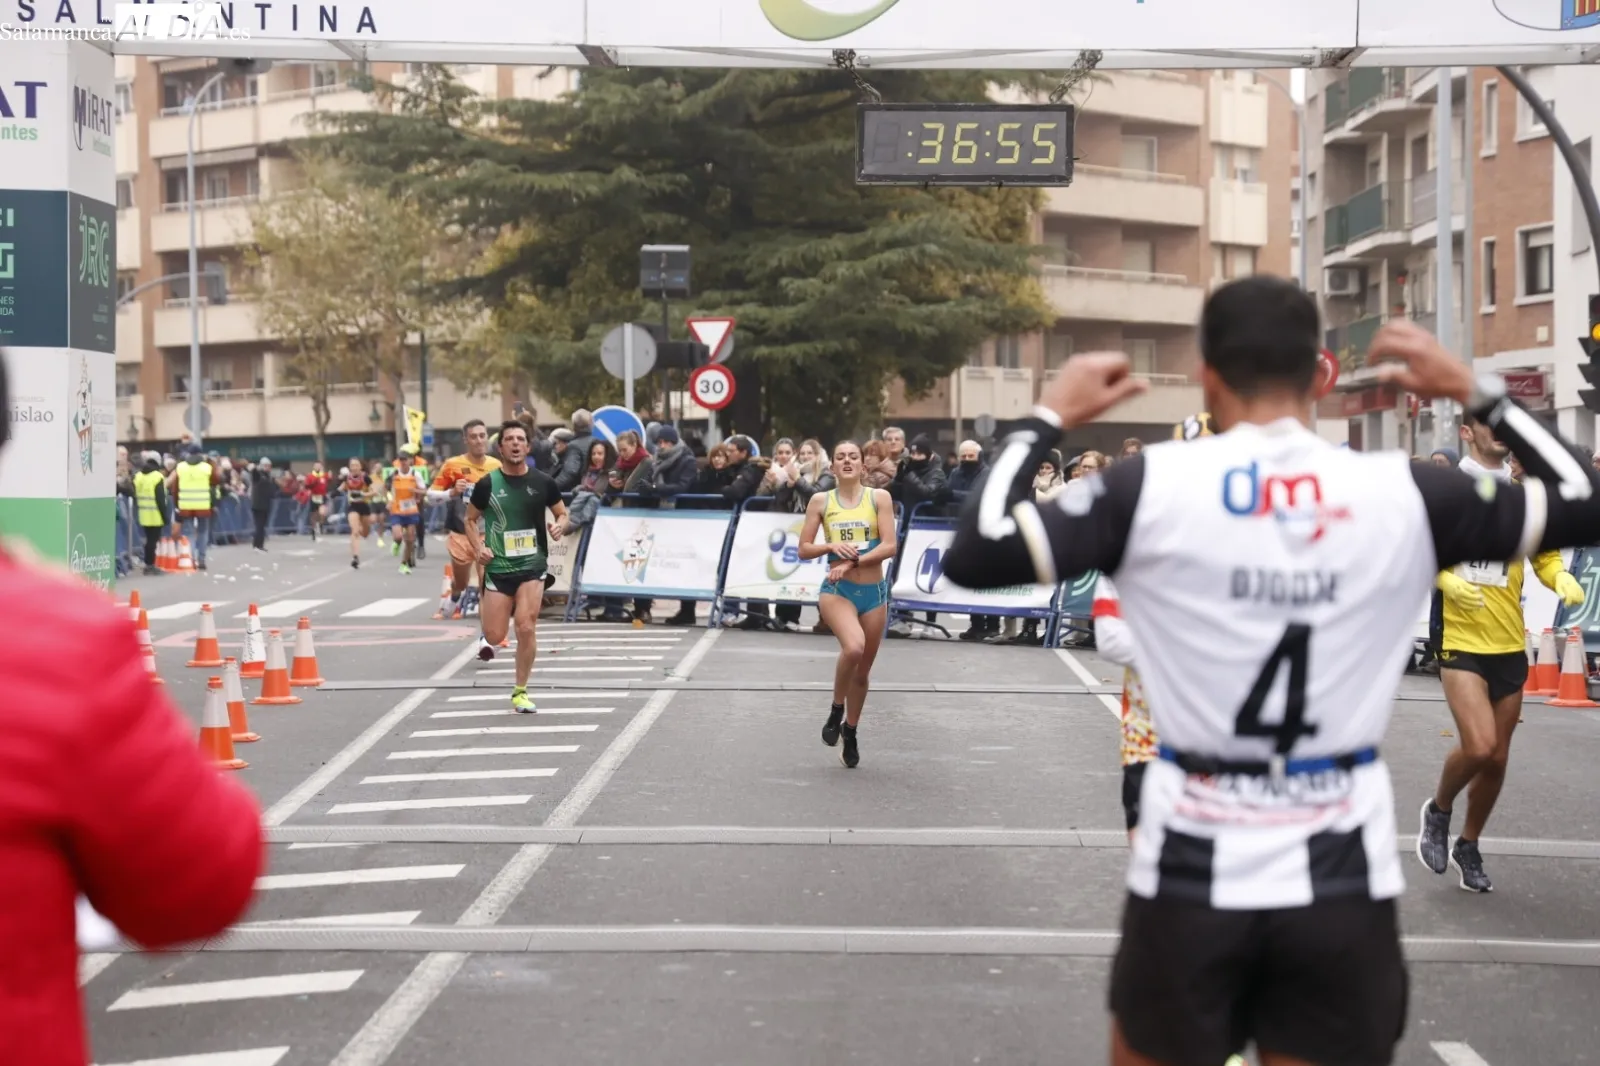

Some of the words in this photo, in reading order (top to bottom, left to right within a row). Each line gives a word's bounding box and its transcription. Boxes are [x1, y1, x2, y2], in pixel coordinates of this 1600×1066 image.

[16, 0, 378, 34] SALNTINA
[700, 379, 724, 394] 30
[514, 536, 525, 548] 117
[840, 528, 854, 541] 85
[1234, 622, 1319, 756] 4
